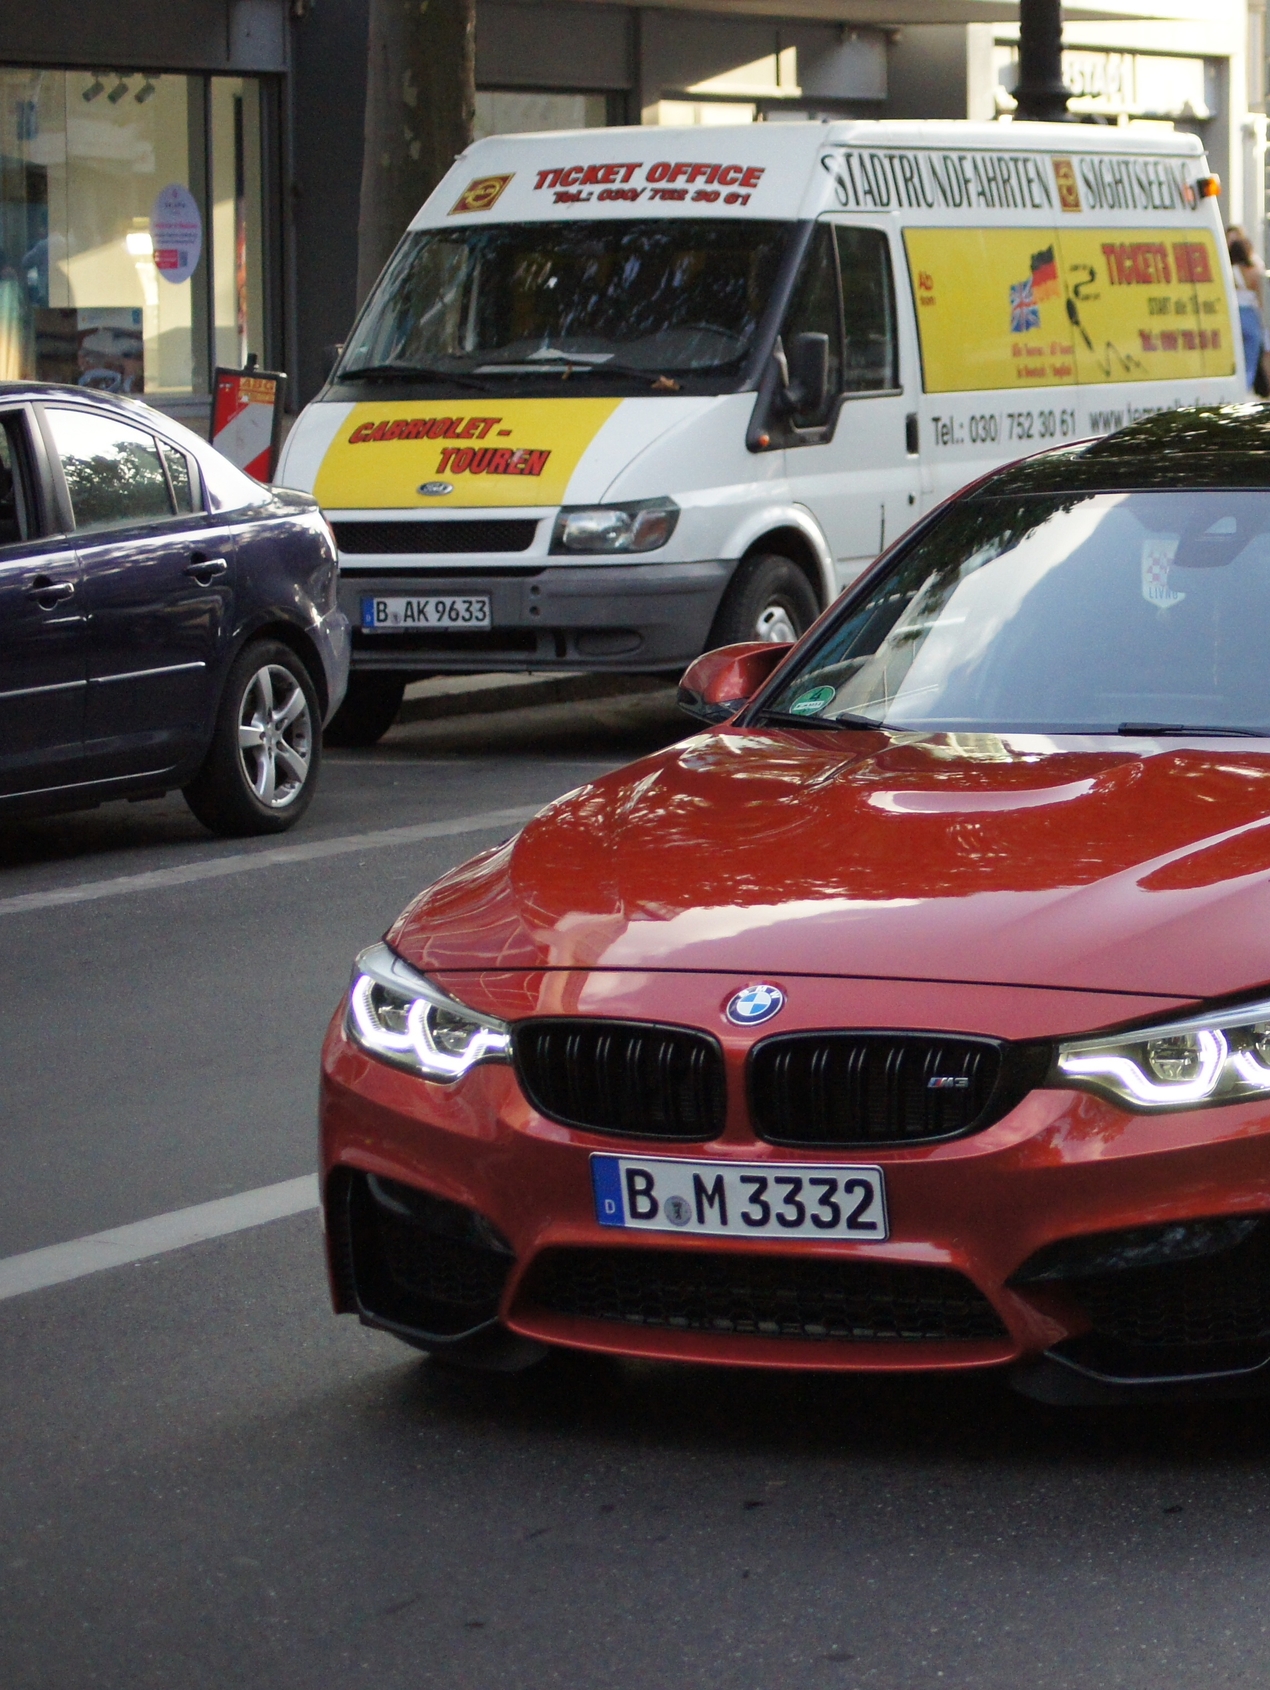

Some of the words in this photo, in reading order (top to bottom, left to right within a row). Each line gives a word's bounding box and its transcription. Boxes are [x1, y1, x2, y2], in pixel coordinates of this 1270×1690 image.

[533, 162, 643, 190] TICKET
[645, 161, 765, 188] OFFICE
[820, 152, 1054, 209] STADTRUNDFAHRTEN
[1079, 156, 1198, 211] SIGHTSEEING
[691, 189, 721, 203] 30
[1101, 242, 1173, 285] TICKETS
[931, 415, 964, 446] Tel.:
[1007, 410, 1035, 440] 752
[1038, 408, 1057, 438] 30
[1060, 407, 1077, 437] 61
[435, 446, 552, 477] TOUREN
[376, 600, 388, 623] B
[404, 600, 430, 623] AK
[434, 600, 487, 623] 9633
[933, 1077, 969, 1088] M3
[604, 1201, 616, 1214] D
[625, 1167, 660, 1221] B
[692, 1172, 729, 1226] M
[739, 1174, 878, 1231] 3332
